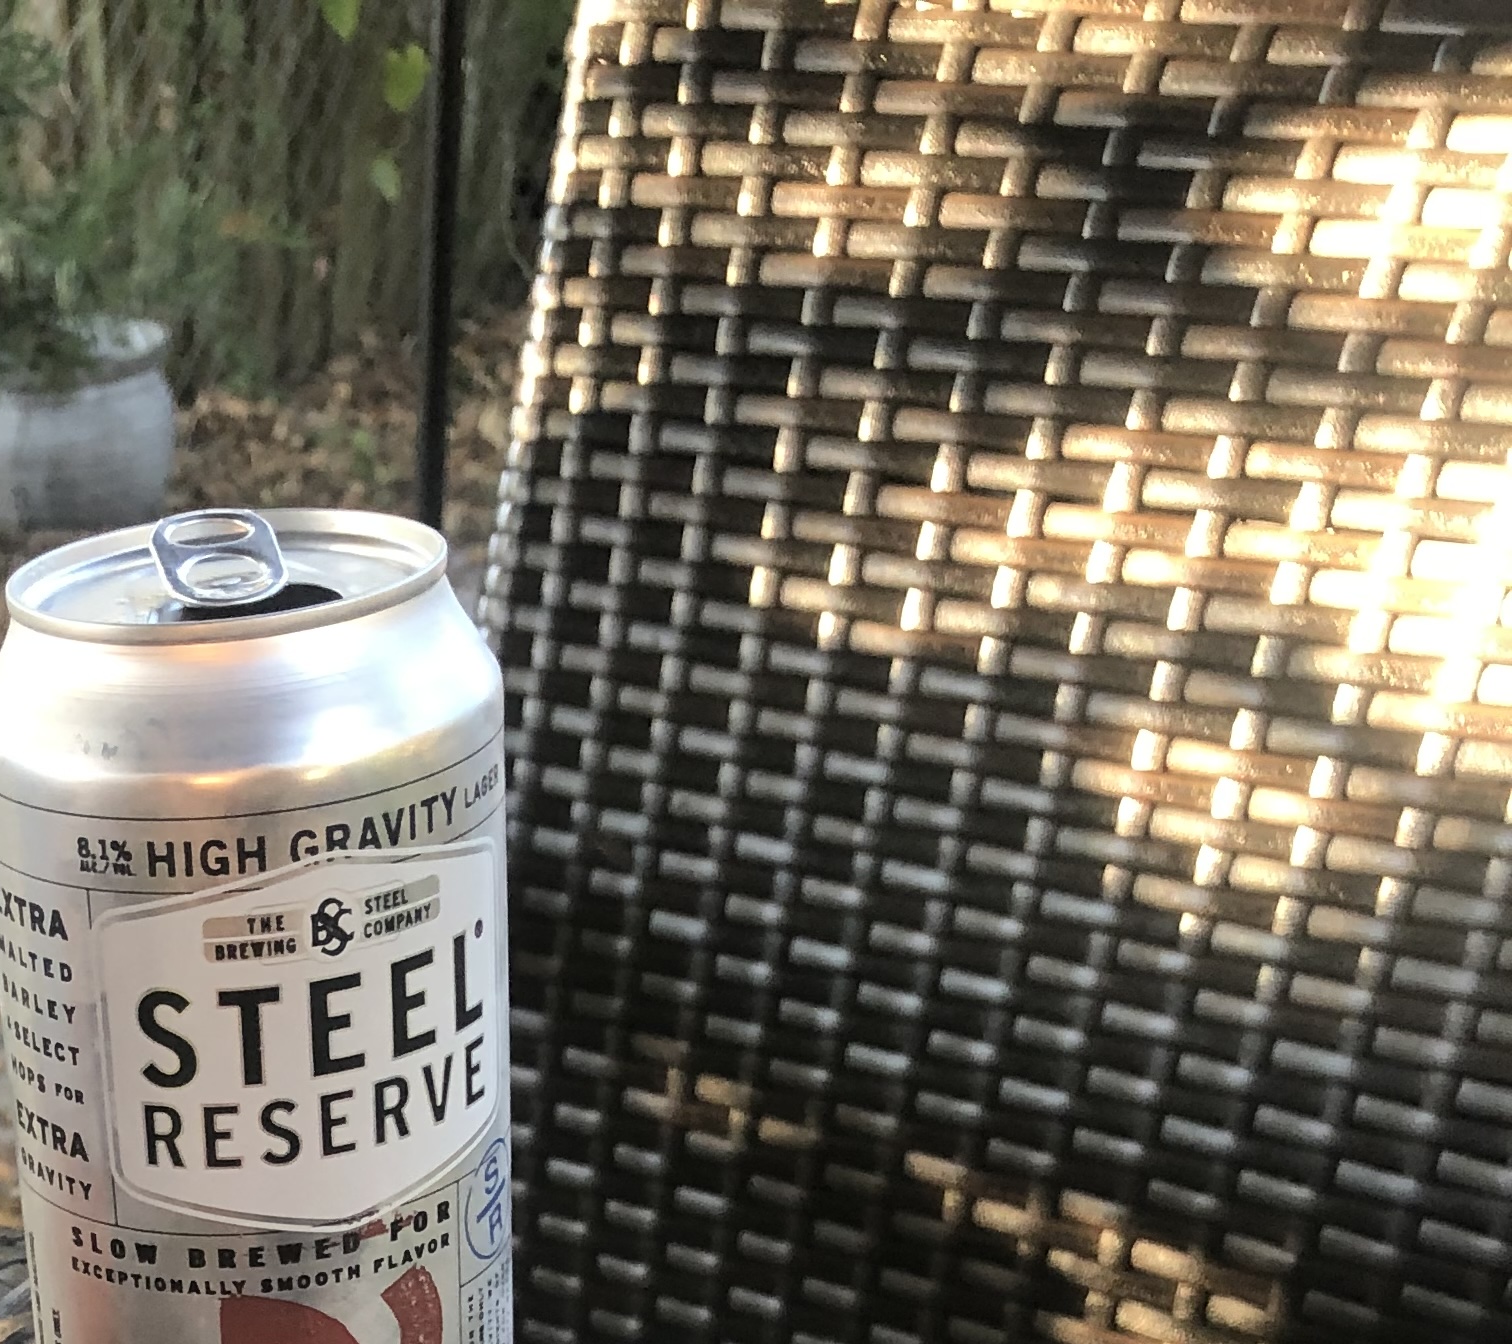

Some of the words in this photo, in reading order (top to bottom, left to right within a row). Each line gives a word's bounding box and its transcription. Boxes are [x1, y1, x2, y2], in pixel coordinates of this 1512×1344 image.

[77, 836, 133, 862] 8.1%
[146, 835, 268, 878] HIGH
[289, 786, 458, 863] GRAVITY
[463, 763, 500, 809] LAGER
[215, 937, 297, 962] BREWING
[363, 902, 432, 939] COMPANY
[246, 914, 285, 935] THE
[364, 887, 409, 915] STEEL
[2, 973, 76, 1025] BARLEY
[13, 1020, 80, 1066] SELECT
[10, 1054, 46, 1094] HOPS
[54, 1083, 85, 1105] FOR
[143, 1034, 486, 1170] RESERVE
[16, 1099, 90, 1163] EXTRA
[21, 1147, 93, 1201] GRAVITY
[71, 1225, 159, 1266] SLOW
[187, 1232, 362, 1270] BREWED
[390, 1200, 452, 1242] FOR
[71, 1256, 247, 1296] EXCEPTIONALLY
[260, 1263, 362, 1294] SMOOTH
[373, 1232, 452, 1275] FLAVOR
